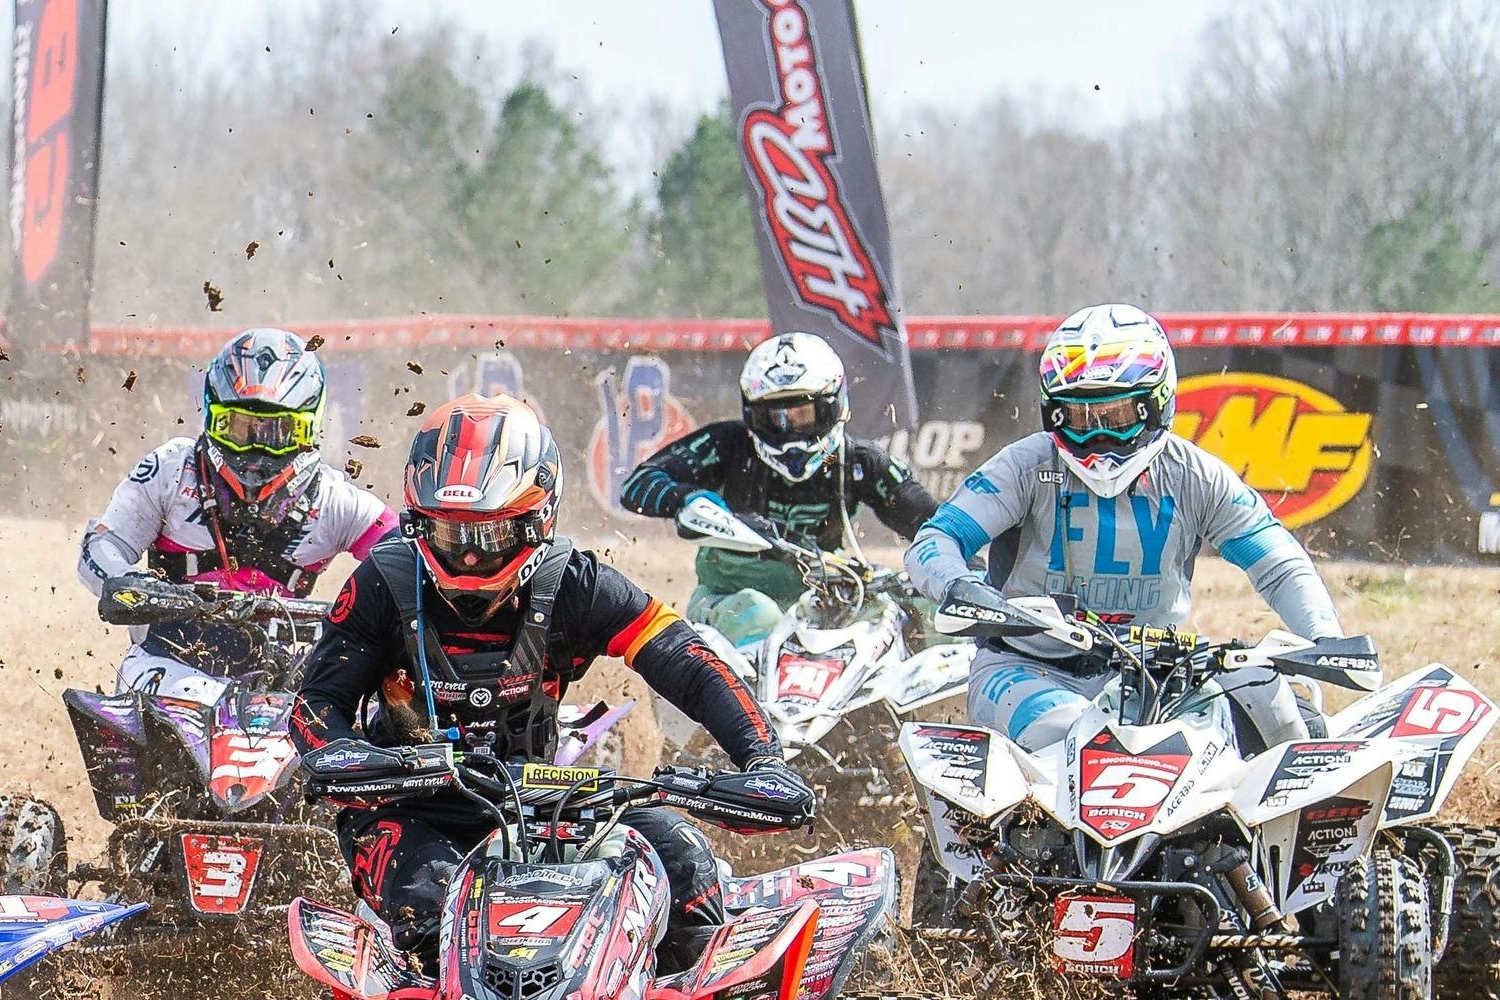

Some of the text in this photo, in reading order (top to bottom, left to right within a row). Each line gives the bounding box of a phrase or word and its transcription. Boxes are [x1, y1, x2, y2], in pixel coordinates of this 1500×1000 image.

[770, 0, 829, 149] MOTO
[1173, 393, 1371, 493] MF
[443, 489, 475, 498] BELL
[1047, 490, 1178, 576] FLY
[1044, 575, 1162, 611] RACING
[1404, 688, 1487, 733] 5
[1080, 765, 1180, 808] 5
[1087, 808, 1148, 821] BORICH
[194, 852, 248, 898] 3
[799, 862, 869, 887] 4
[497, 904, 573, 934] 4
[1052, 900, 1136, 963] 5
[1065, 962, 1119, 975] BORICH
